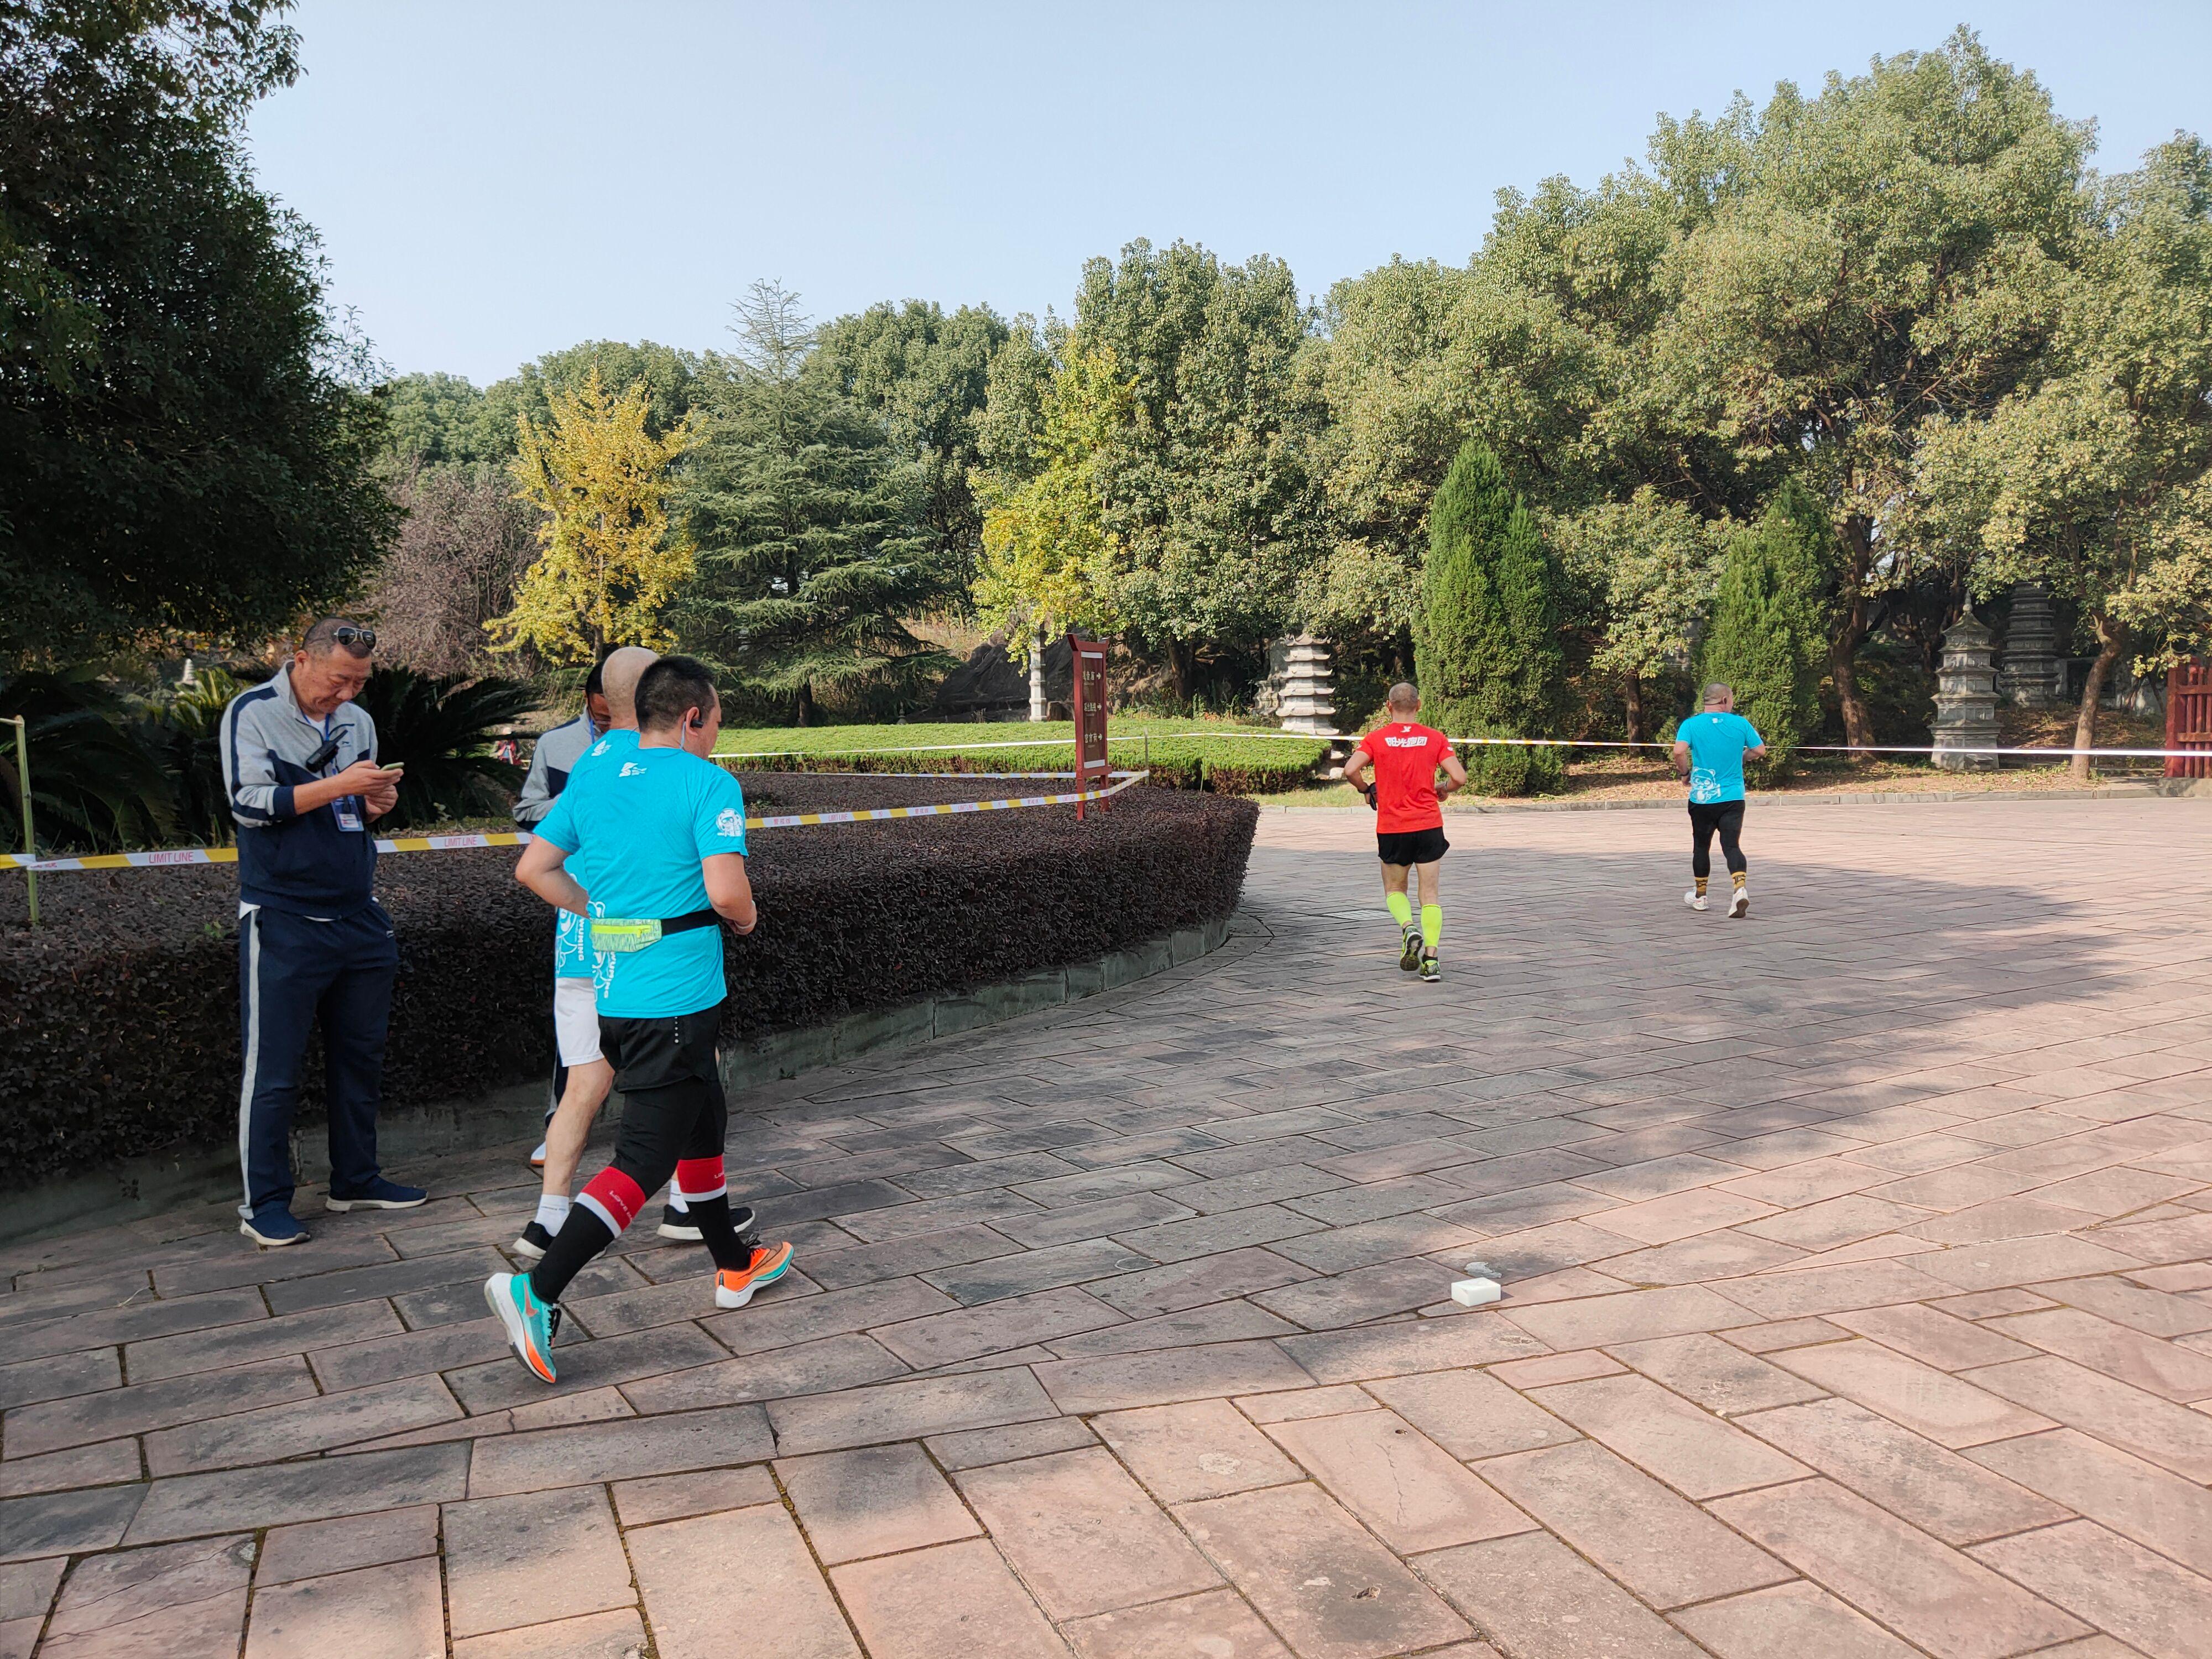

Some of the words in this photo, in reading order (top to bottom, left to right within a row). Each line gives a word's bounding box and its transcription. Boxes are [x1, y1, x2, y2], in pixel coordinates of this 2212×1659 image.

[445, 837, 462, 847] LIMIT
[462, 836, 477, 846] LINE
[149, 853, 174, 864] LIMIT
[174, 852, 194, 863] LINE
